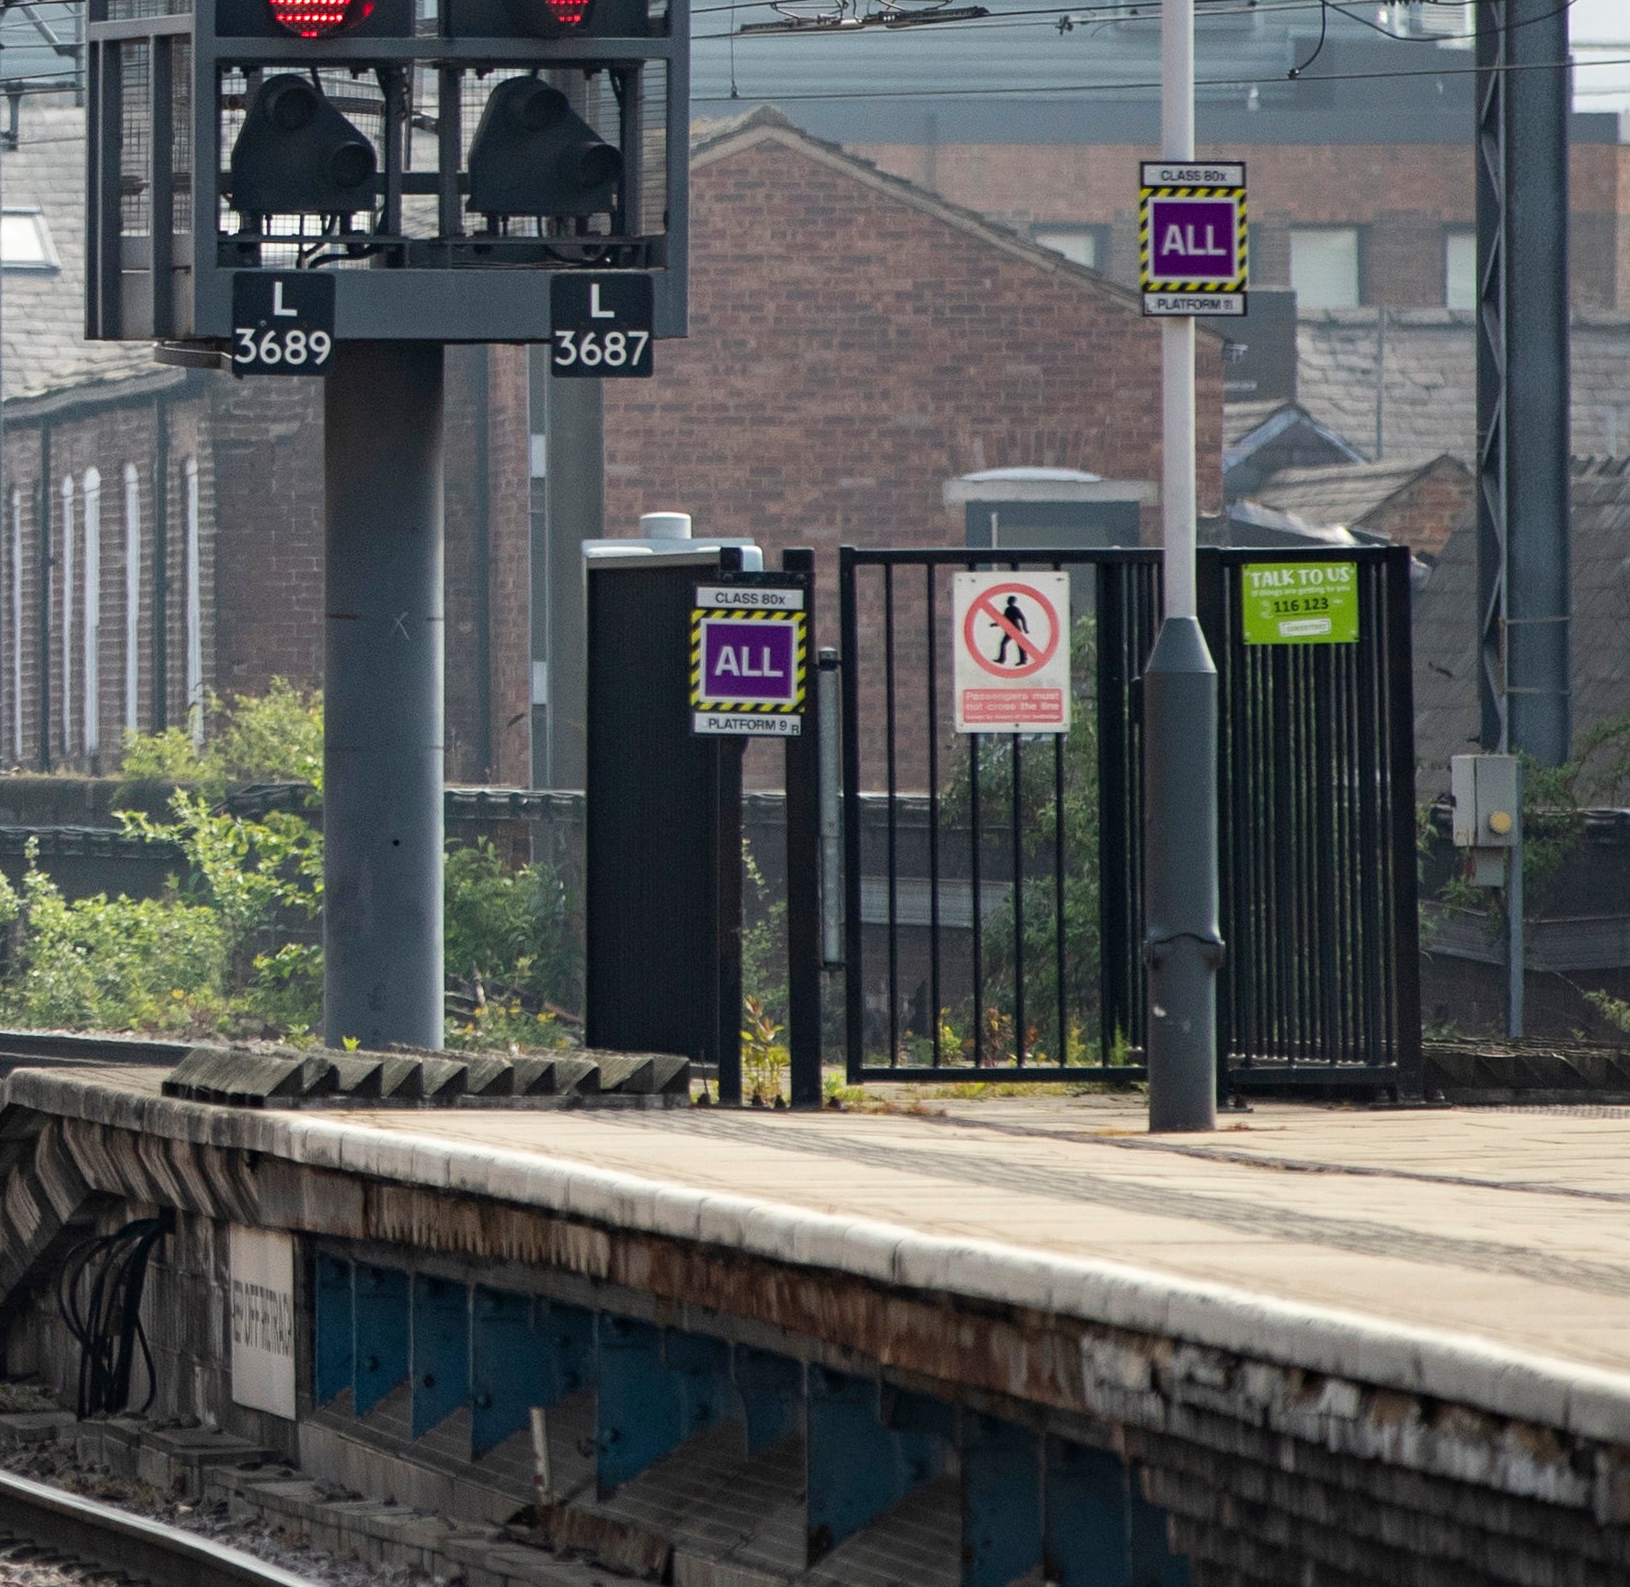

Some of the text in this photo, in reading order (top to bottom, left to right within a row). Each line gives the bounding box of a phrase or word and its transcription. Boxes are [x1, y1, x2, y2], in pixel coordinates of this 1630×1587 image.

[1161, 170, 1227, 182] CLASS 80x
[1161, 224, 1227, 256] ALL
[274, 281, 298, 316] L
[591, 283, 615, 318] L
[1157, 298, 1221, 310] PLATFORM
[234, 328, 332, 365] 3689
[555, 330, 650, 367] 3687
[1250, 566, 1351, 588] TALK TO US
[715, 592, 786, 605] CLASS 80x
[1273, 599, 1299, 613] 116
[1304, 597, 1329, 611] 123
[714, 645, 784, 678] ALL
[708, 717, 800, 734] PLATFORM 9 R
